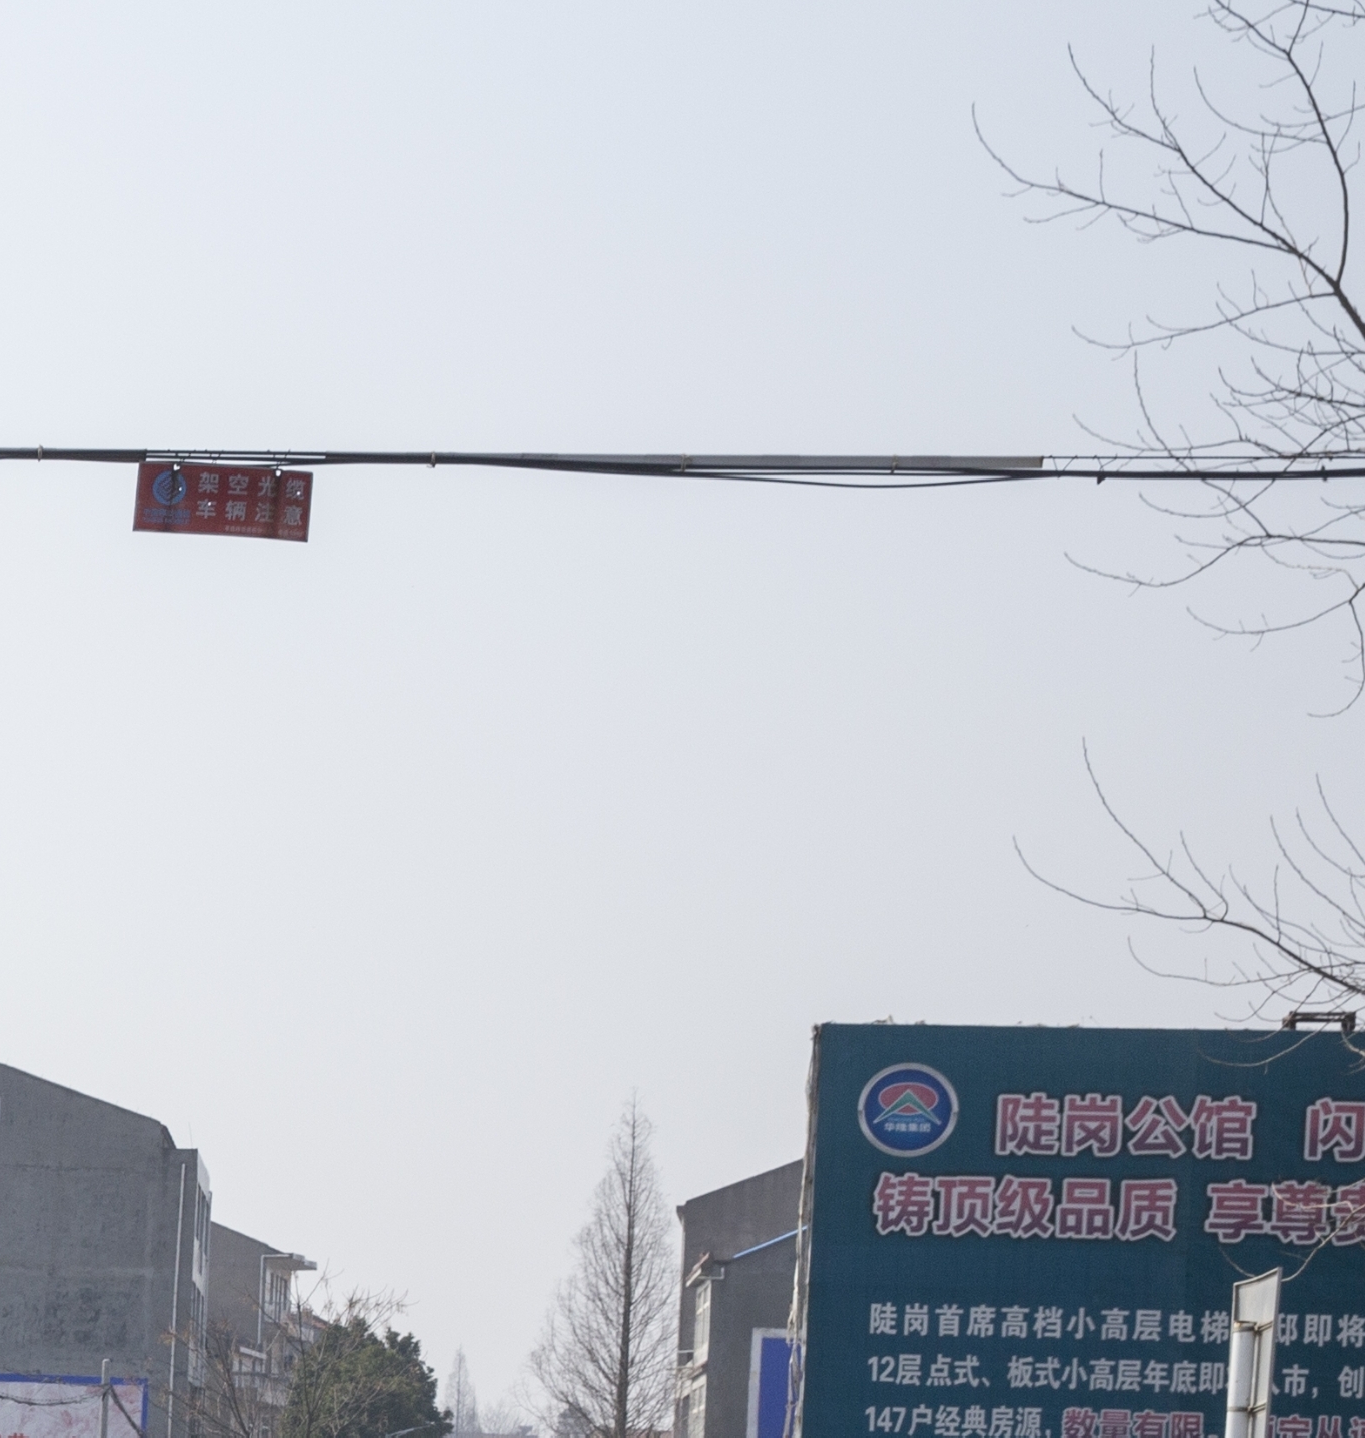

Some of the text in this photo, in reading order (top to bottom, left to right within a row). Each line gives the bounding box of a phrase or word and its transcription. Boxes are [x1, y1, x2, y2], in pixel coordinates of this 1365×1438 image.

[198, 471, 306, 501] 架空光缆
[196, 498, 302, 526] 车辆注意
[996, 1094, 1365, 1162] 陡岗公馆 闪
[874, 1172, 1177, 1242] 铸顶级品质
[870, 1303, 1365, 1348] 陡岗首席高档小高层电梯邸即将
[868, 1354, 1365, 1399] 12层点式、板式小高层年底即市，创
